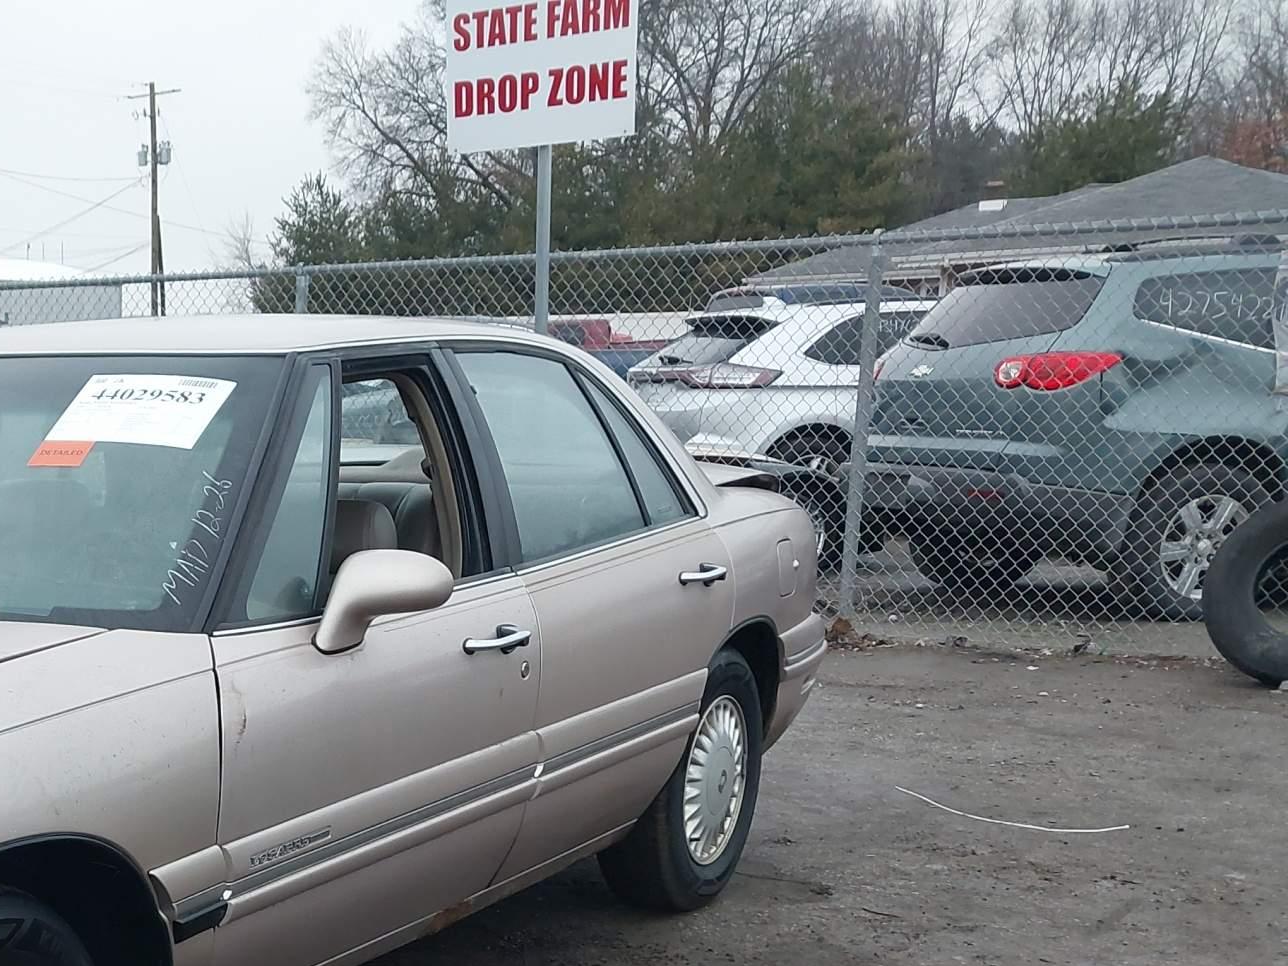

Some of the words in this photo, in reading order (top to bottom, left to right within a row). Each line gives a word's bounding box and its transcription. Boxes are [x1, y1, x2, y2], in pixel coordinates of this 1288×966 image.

[453, 3, 538, 52] STATE
[546, 0, 631, 39] FARM
[453, 72, 540, 118] DROP
[547, 59, 628, 107] ZONE
[91, 388, 206, 404] 44029583
